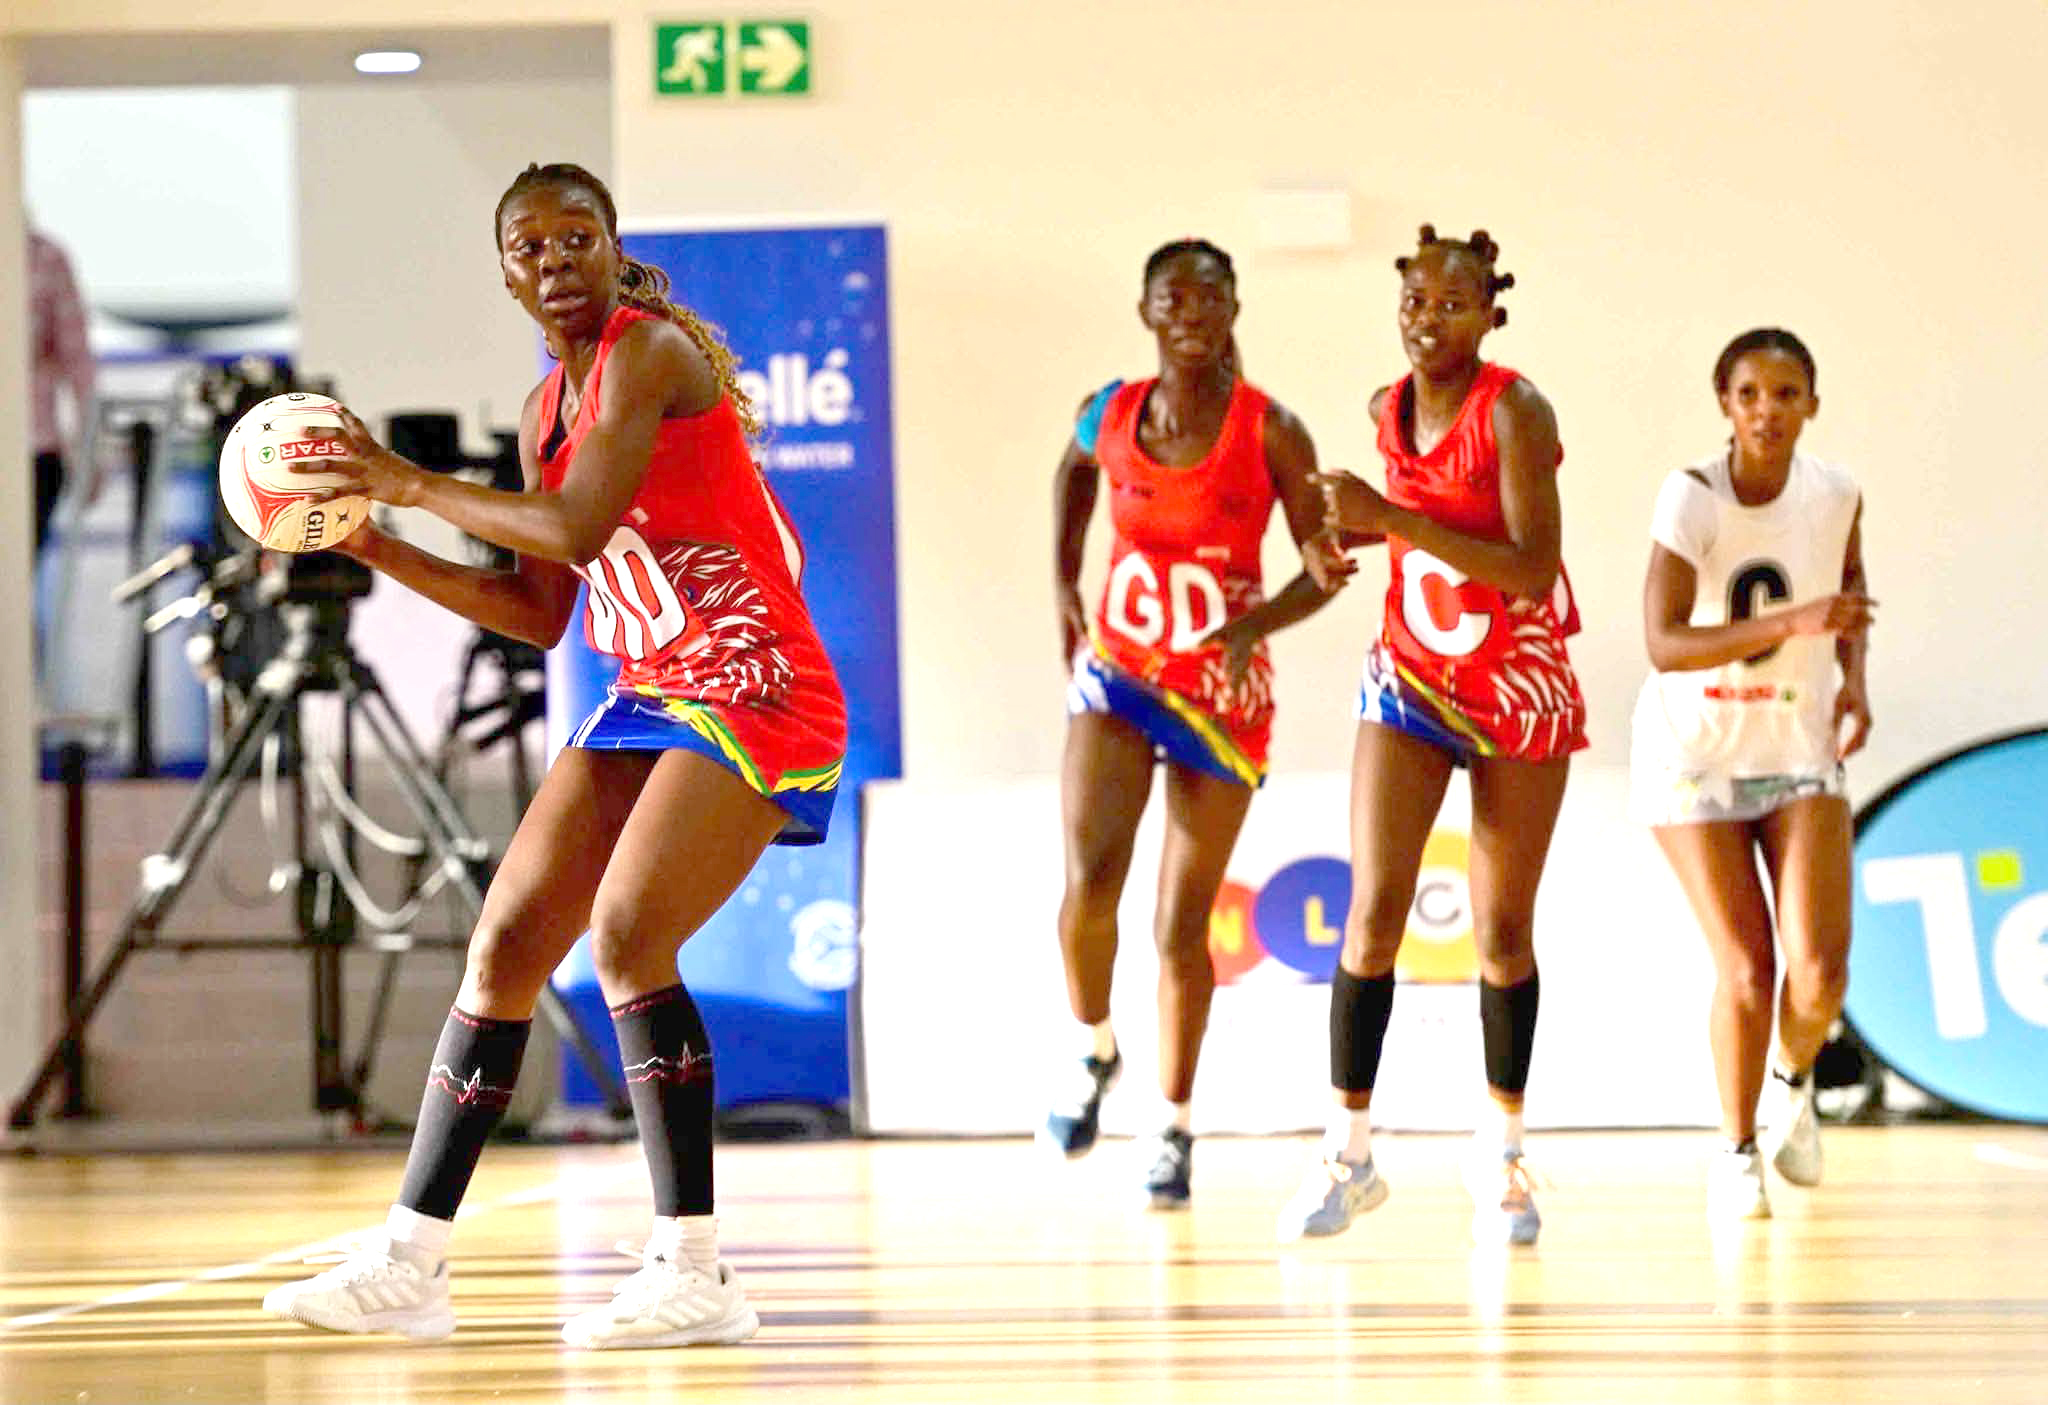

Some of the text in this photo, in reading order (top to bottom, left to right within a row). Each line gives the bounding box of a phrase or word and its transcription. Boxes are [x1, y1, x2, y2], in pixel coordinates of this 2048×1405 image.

[281, 440, 345, 458] SPAR
[1106, 551, 1228, 653] GD
[1401, 548, 1492, 656] C
